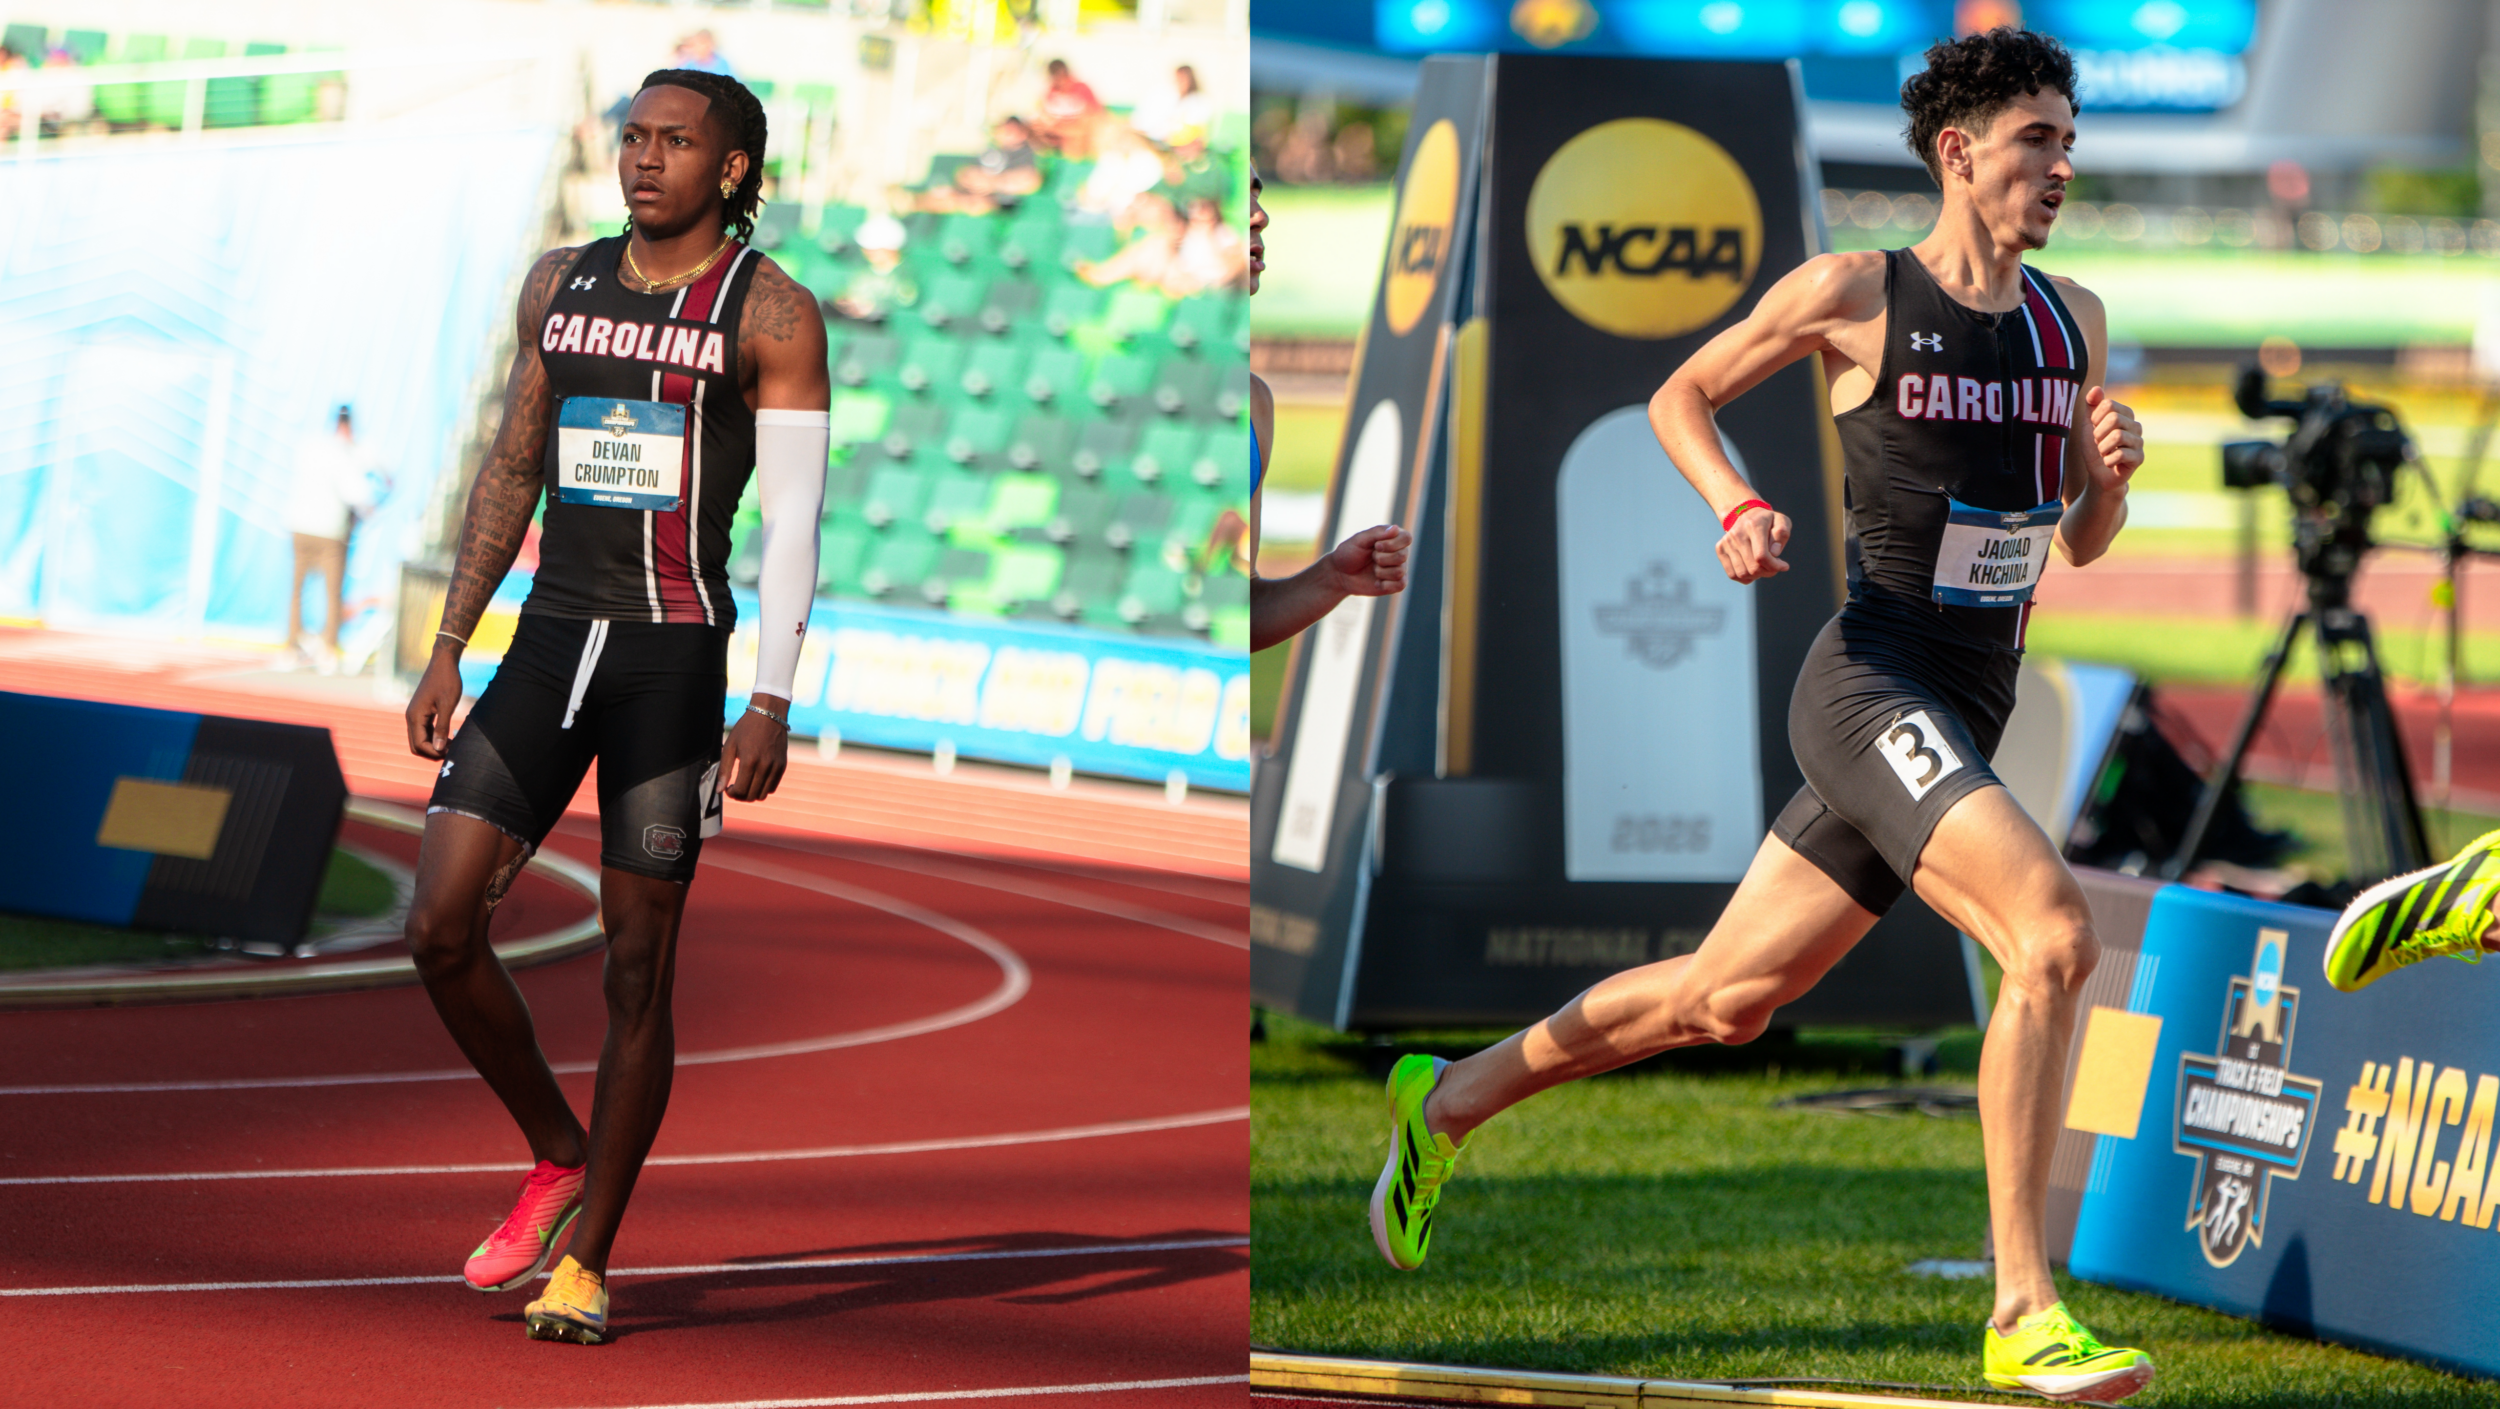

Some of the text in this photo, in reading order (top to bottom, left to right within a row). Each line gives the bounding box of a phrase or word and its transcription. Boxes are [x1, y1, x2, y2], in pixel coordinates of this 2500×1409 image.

[1556, 223, 1744, 283] NCAA
[542, 313, 725, 375] CAROLINA
[1897, 372, 2080, 429] CAROLINA
[575, 463, 659, 488] CRUMPTON
[592, 440, 641, 462] DEVAN
[1977, 537, 2031, 560] JAOUAD
[1968, 562, 2028, 585] KHCHINA
[1888, 722, 1942, 788] 3
[2215, 1056, 2285, 1097] TRACK & FIELD
[2183, 1084, 2304, 1149] CHAMPIONSHIPS
